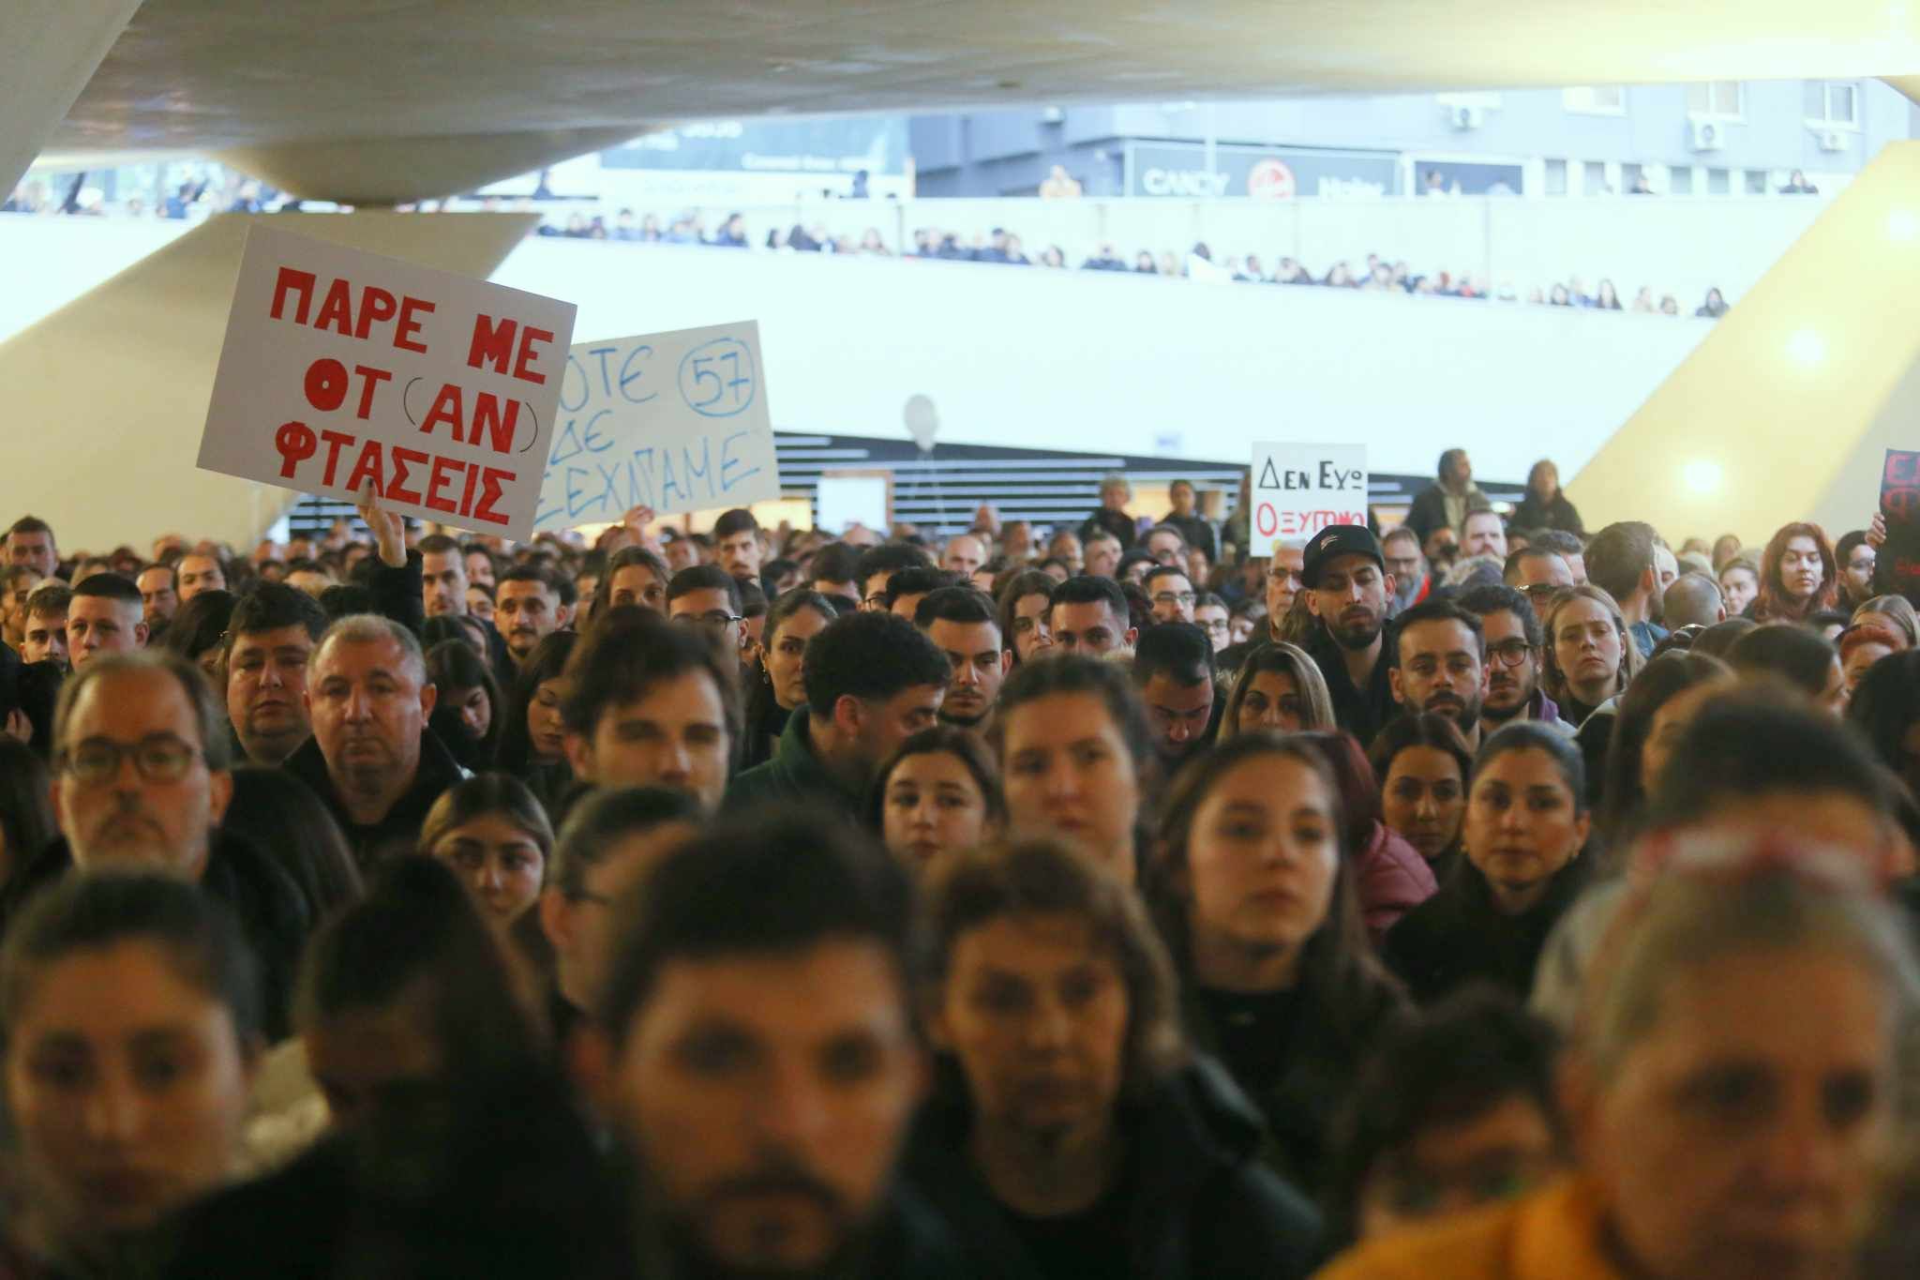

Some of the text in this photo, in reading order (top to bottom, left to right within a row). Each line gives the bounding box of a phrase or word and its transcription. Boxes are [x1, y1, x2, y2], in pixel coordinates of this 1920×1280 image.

[270, 266, 554, 385] ΠΑΡΕ ΜΕ
[560, 344, 751, 413] ΟΤΕ 57
[550, 409, 616, 466] ΔΕ
[275, 420, 517, 526] ΦΤΑΣΕΙΣ
[1258, 455, 1311, 490] ΔΕΝ
